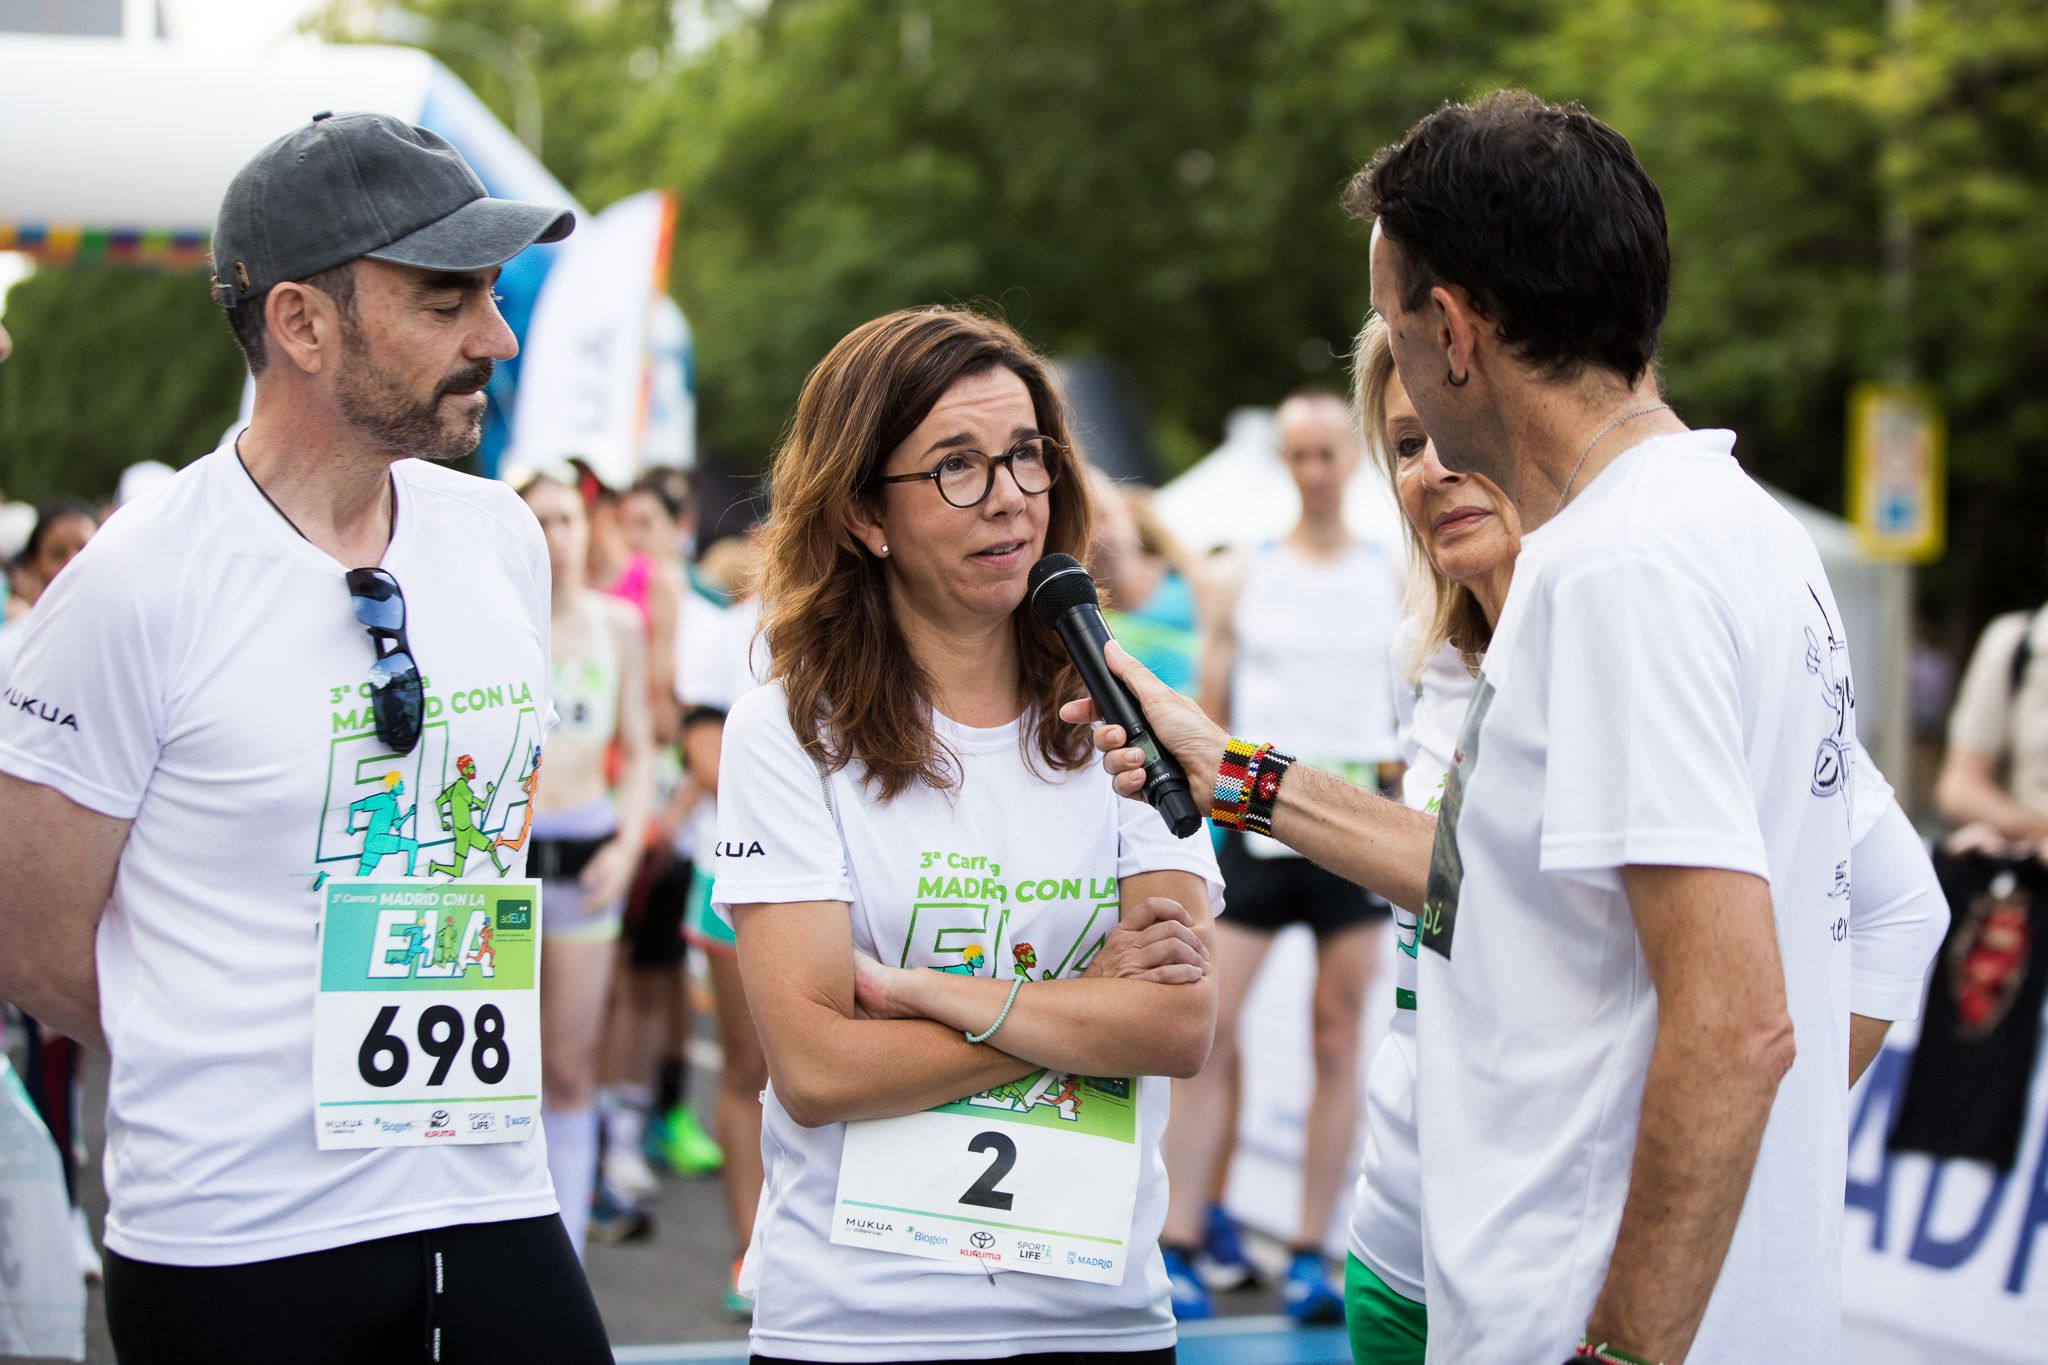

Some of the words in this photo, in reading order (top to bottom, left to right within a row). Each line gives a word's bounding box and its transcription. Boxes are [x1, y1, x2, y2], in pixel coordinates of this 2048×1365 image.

[4, 686, 79, 732] UKUA
[331, 697, 444, 733] MAD
[451, 685, 504, 713] CON
[508, 681, 534, 704] LA
[919, 851, 941, 869] 3ª
[917, 876, 1008, 904] MADRD
[1014, 878, 1082, 903] CON
[1089, 877, 1117, 900] LA
[379, 892, 439, 907] MADRID
[441, 893, 467, 907] CON
[468, 893, 485, 907] LA
[367, 908, 496, 980] ELA
[358, 1003, 510, 1088] 698
[472, 1121, 490, 1131] LIFE
[958, 1130, 1018, 1212] 2
[845, 1217, 894, 1232] MUKUA
[914, 1231, 948, 1246] Biogen
[1017, 1241, 1046, 1252] SPORT
[1019, 1249, 1041, 1261] LIFE
[1077, 1256, 1113, 1270] MADRID
